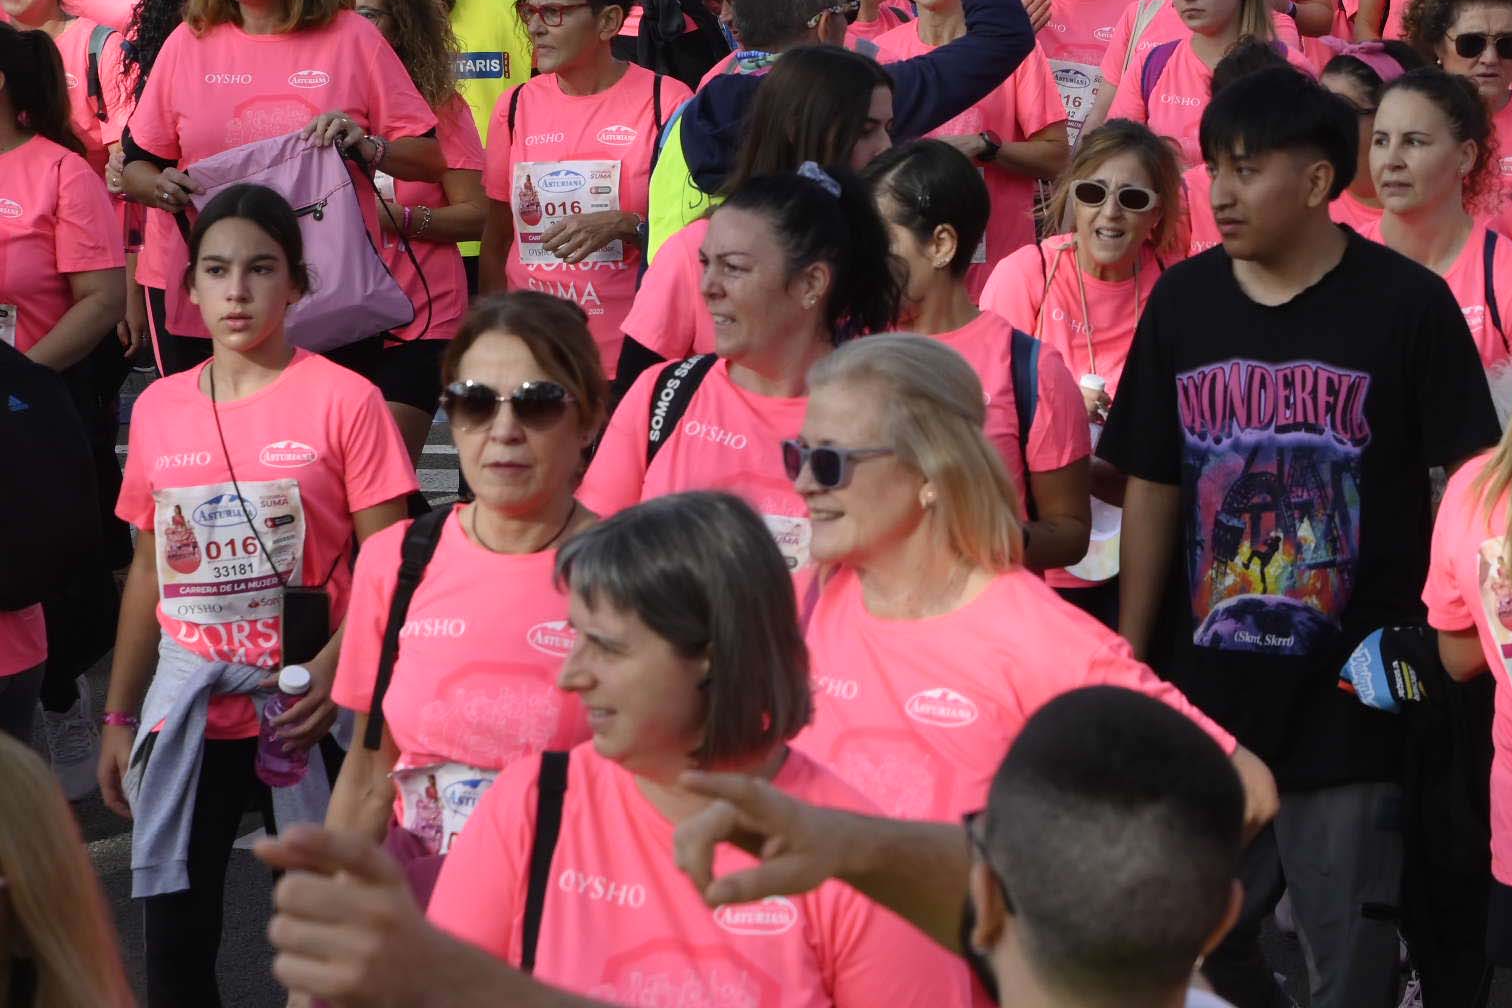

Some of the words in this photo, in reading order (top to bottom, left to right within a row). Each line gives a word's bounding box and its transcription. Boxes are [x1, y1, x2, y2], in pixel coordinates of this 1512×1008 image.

[204, 73, 253, 85] OYSHO
[525, 131, 565, 147] OYSHO
[544, 200, 583, 217] 016
[649, 377, 681, 442] SOMOS
[1176, 358, 1372, 449] WONDERFUL
[684, 419, 748, 451] OYSHO
[155, 451, 212, 470] OYSHO
[261, 498, 289, 509] SUMA
[205, 535, 259, 561] 016
[213, 562, 255, 579] 33181
[179, 585, 218, 594] CARRERA
[219, 584, 232, 592] DE
[233, 582, 247, 591] LA
[247, 577, 279, 589] MUJER
[177, 604, 223, 616] OYSHO
[558, 868, 647, 910] OYSHO
